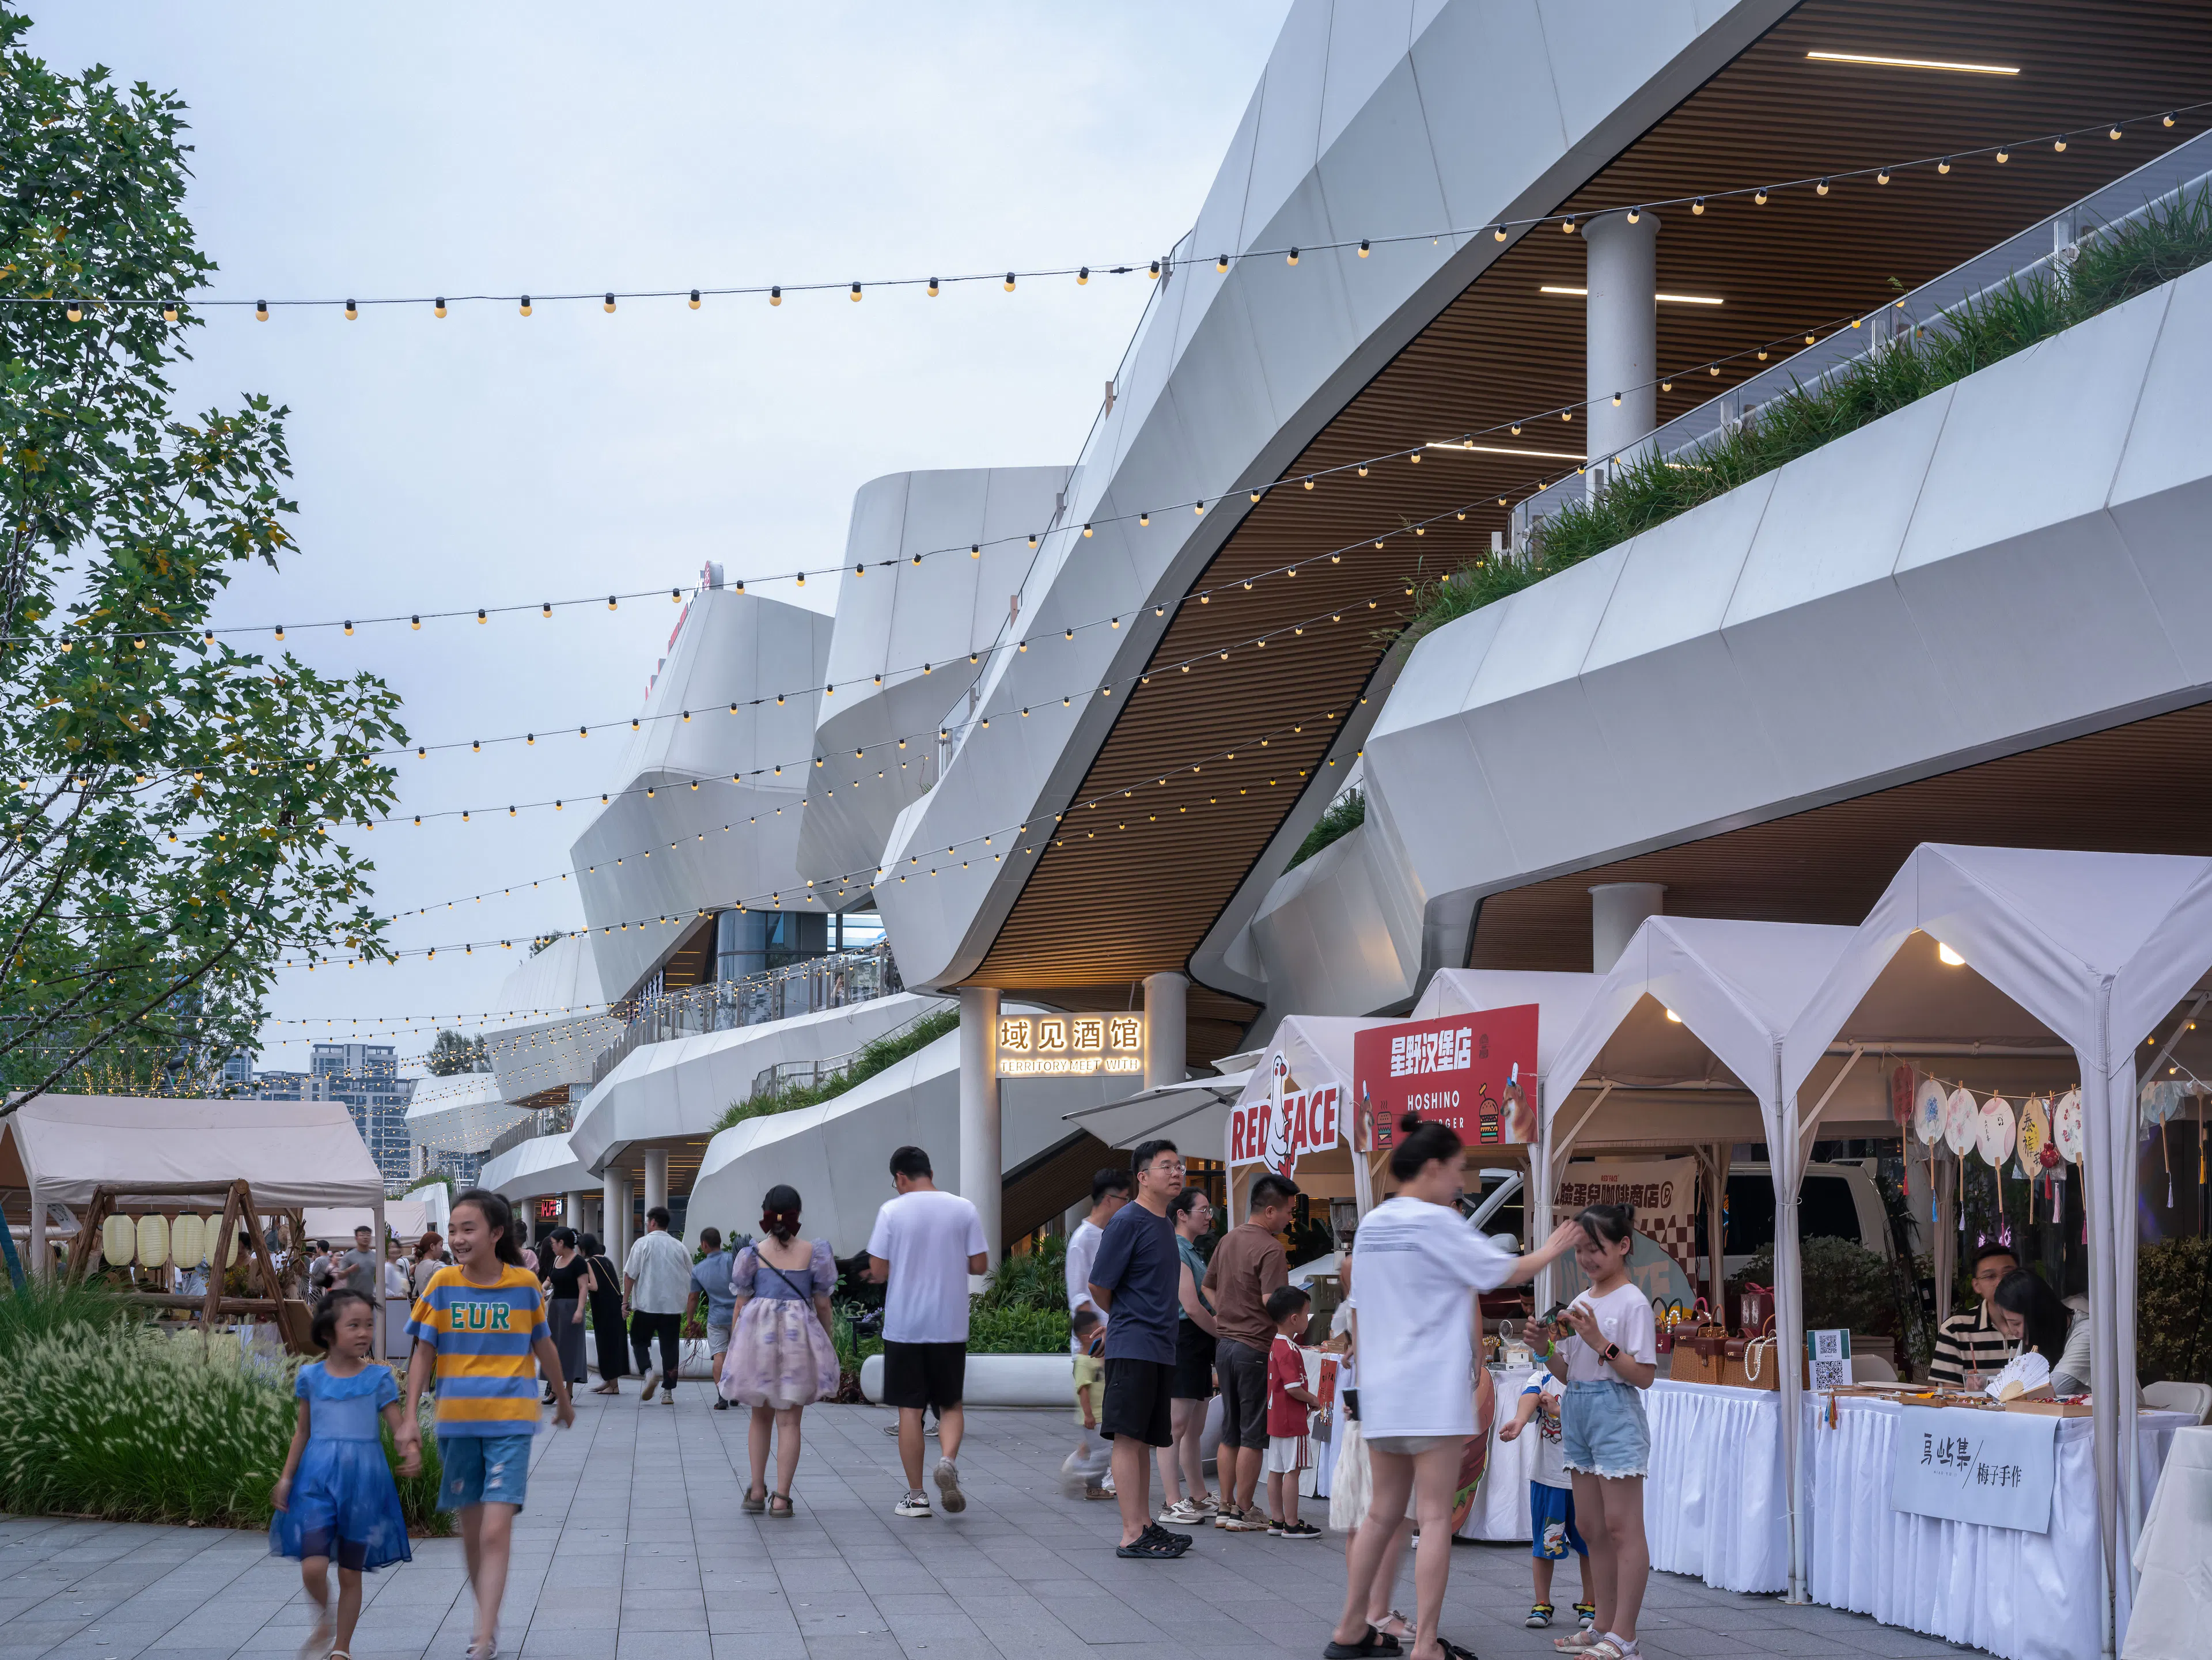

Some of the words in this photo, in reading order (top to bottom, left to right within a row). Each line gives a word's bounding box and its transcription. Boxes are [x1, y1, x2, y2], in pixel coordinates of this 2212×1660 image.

[1001, 1019, 1138, 1049] 域见酒馆
[1000, 1060, 1067, 1072] TERRITORY
[1069, 1059, 1101, 1071] MEET
[1106, 1059, 1138, 1070] WITH
[1390, 1027, 1472, 1078] 星野汉堡店
[1407, 1090, 1460, 1111] HOSHINO
[1231, 1105, 1272, 1162] RED
[1283, 1087, 1337, 1150] FACE
[450, 1301, 510, 1331] EUR
[1976, 1462, 2022, 1488] 梅子手作
